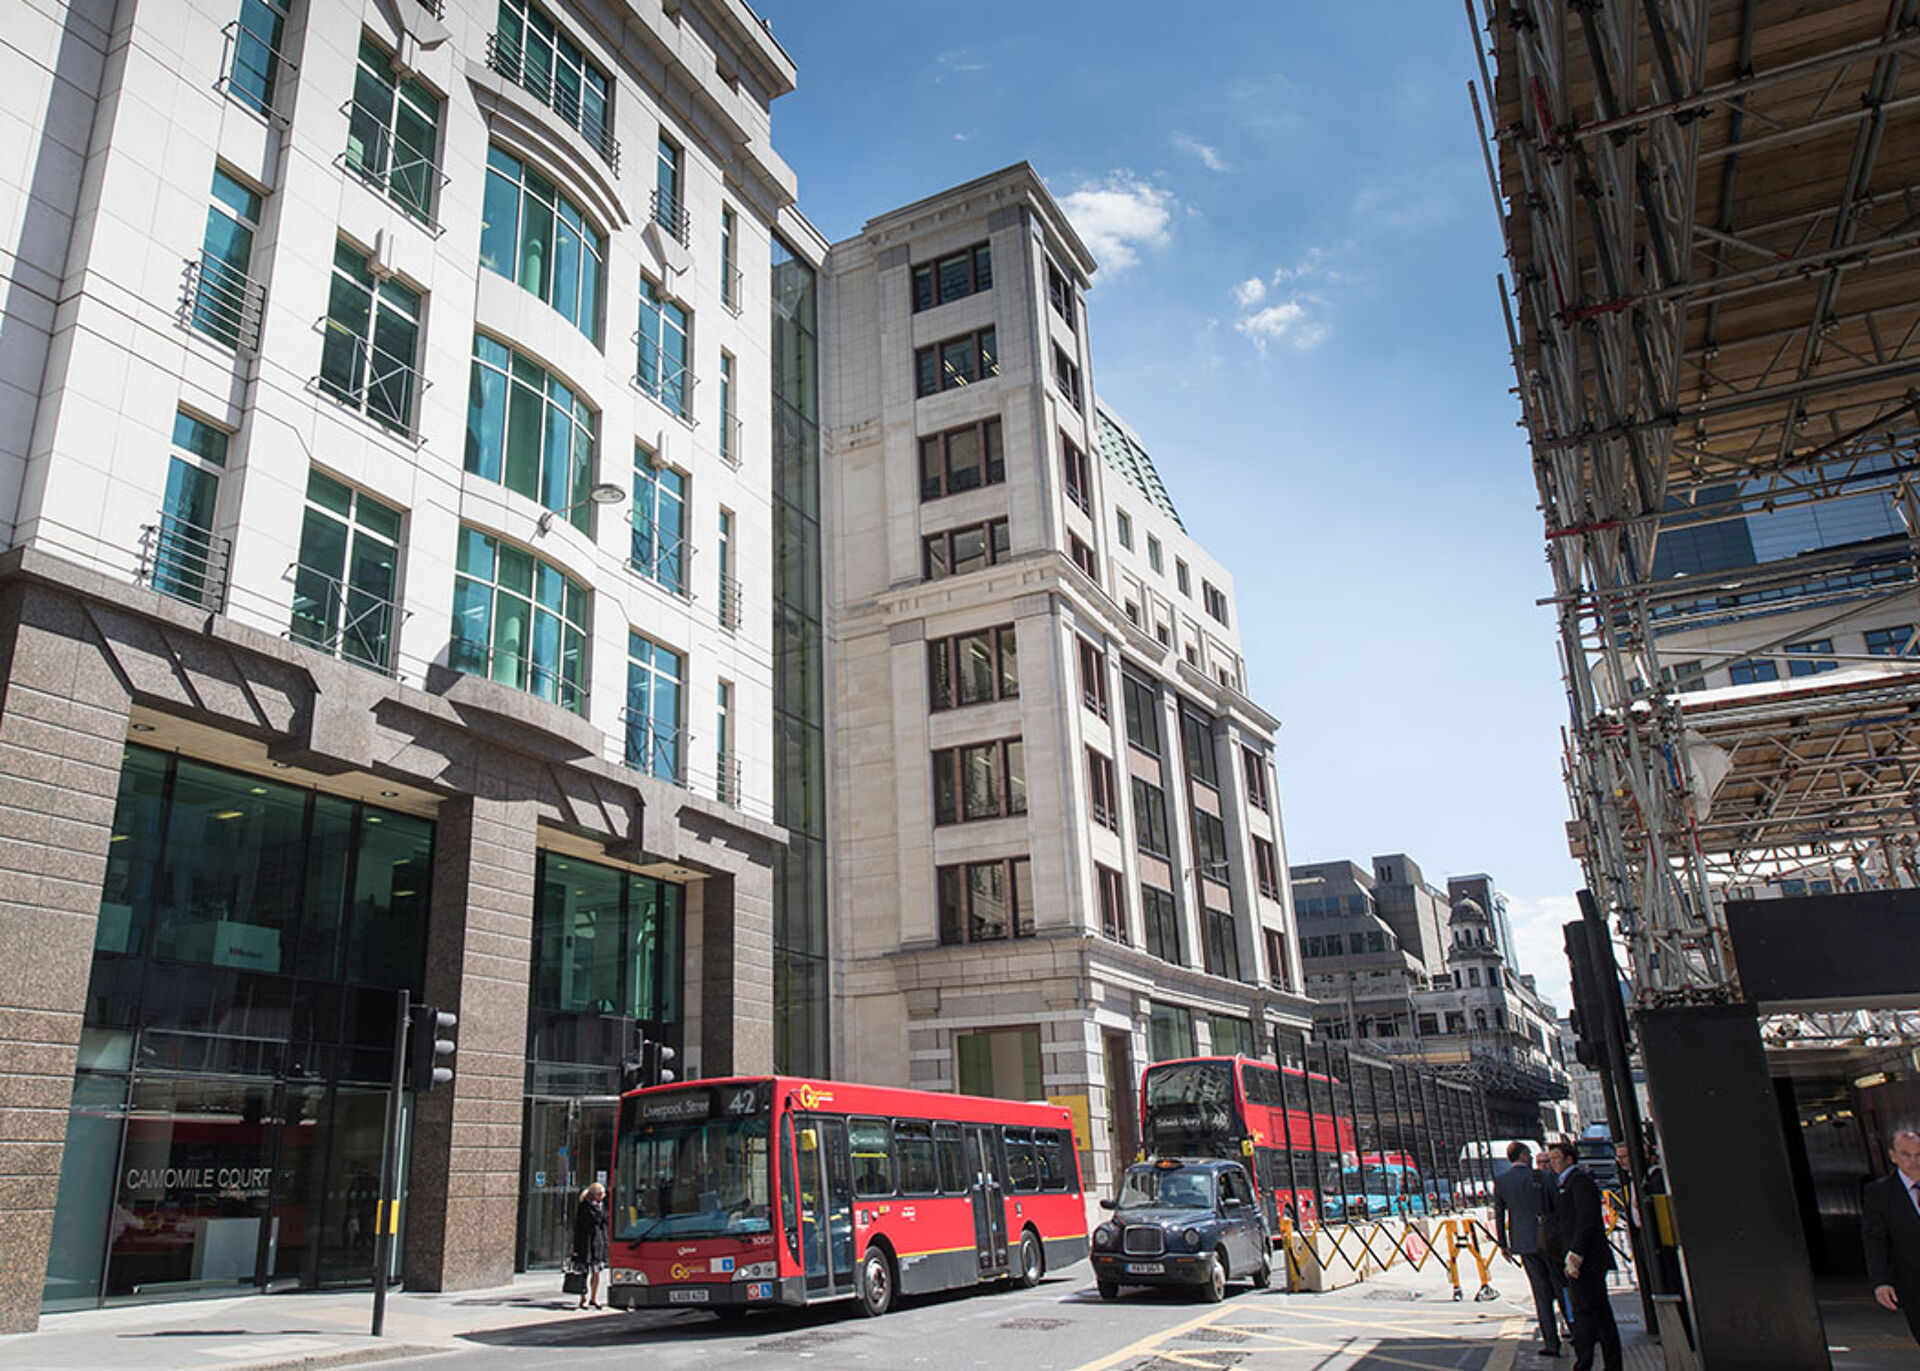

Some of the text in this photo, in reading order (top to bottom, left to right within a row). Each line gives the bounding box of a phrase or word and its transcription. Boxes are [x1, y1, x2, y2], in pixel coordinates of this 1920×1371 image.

[643, 1103, 682, 1119] Liverpool
[728, 1089, 756, 1114] 42
[126, 1167, 272, 1189] CAMOMILE COURT
